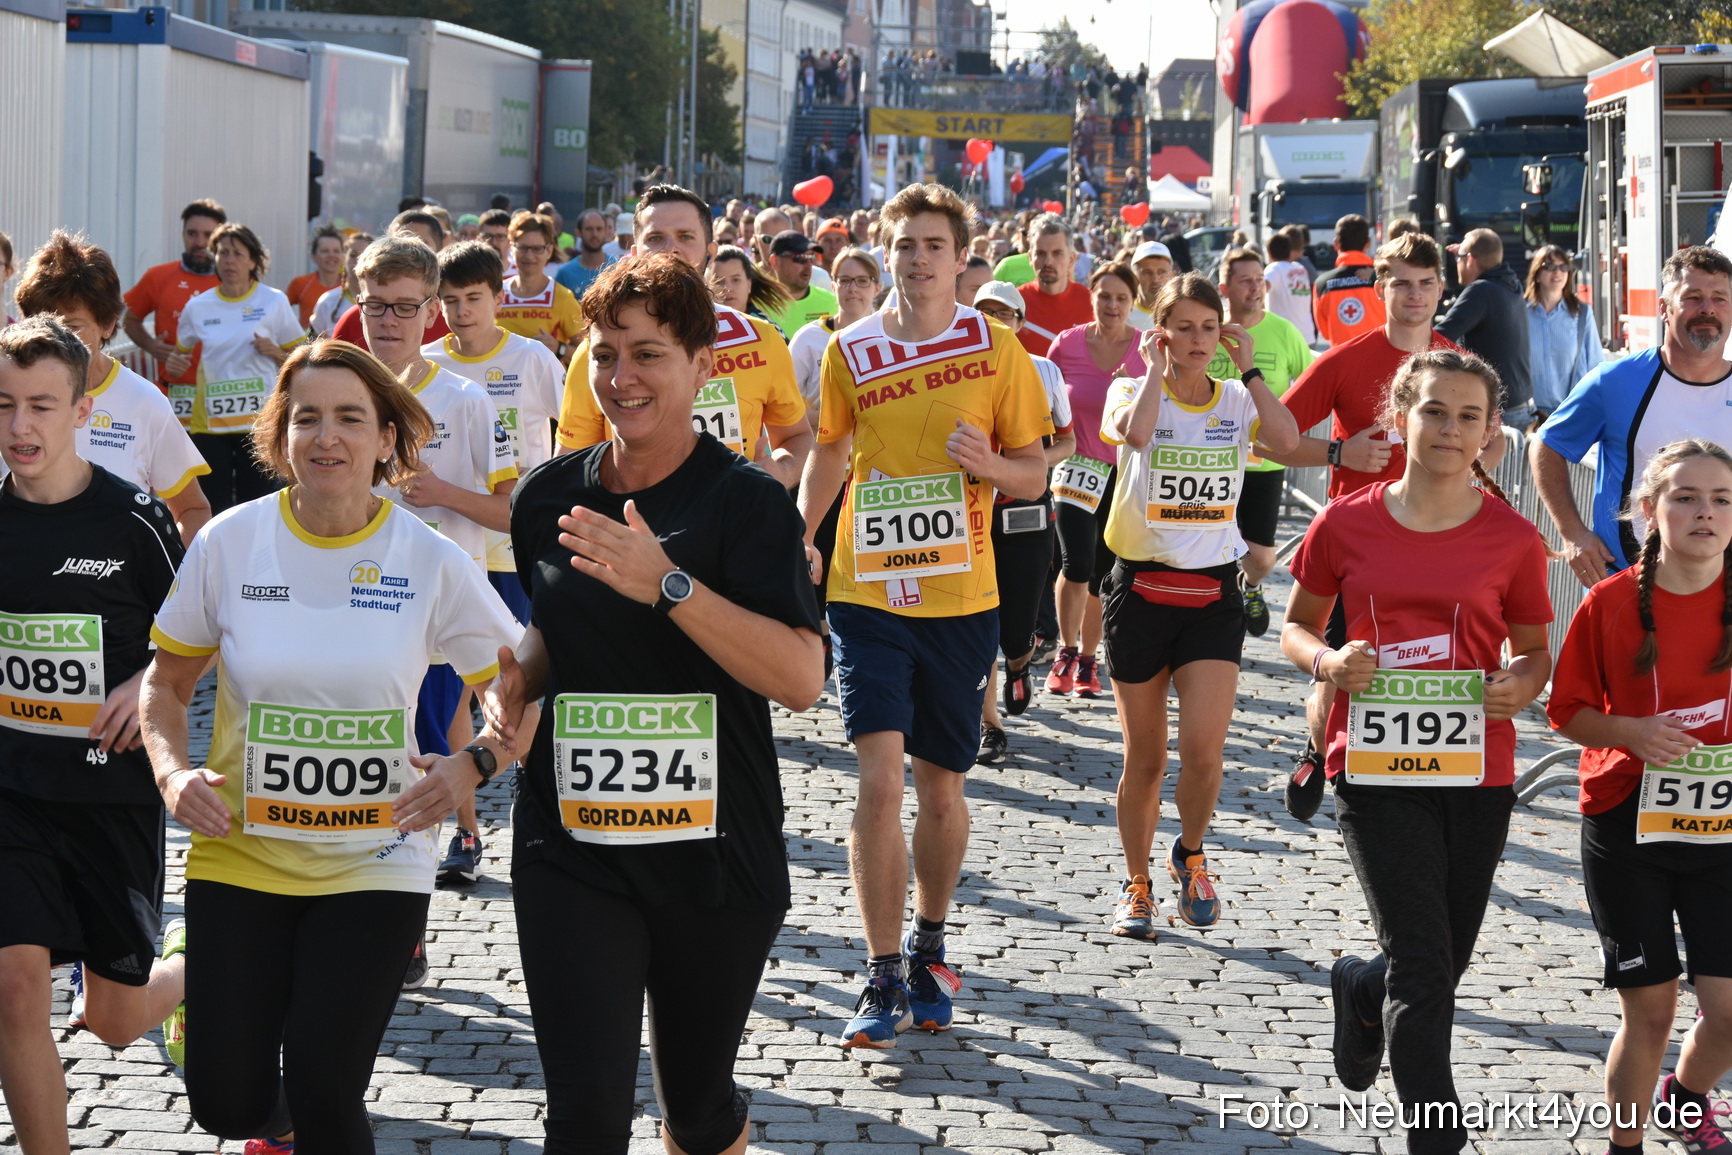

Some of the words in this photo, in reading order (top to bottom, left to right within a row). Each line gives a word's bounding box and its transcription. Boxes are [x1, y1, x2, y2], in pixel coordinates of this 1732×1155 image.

[935, 115, 1006, 134] START
[522, 309, 552, 319] BÖGL
[487, 371, 503, 382] 20
[857, 378, 918, 412] MAX
[925, 360, 996, 390] BÖGL
[210, 379, 261, 394] BOCK
[213, 396, 260, 415] 5273
[91, 414, 111, 428] 20
[1205, 426, 1240, 434] Neumarkter
[1207, 417, 1220, 427] 20
[90, 429, 136, 441] Neumarkter
[90, 439, 126, 450] Stadtlauf
[1157, 448, 1234, 469] BOCK
[1055, 467, 1099, 491] 5119
[1159, 475, 1230, 501] 5043
[861, 478, 954, 508] BOCK
[866, 510, 954, 546] 5100
[52, 558, 106, 576] JURA
[883, 551, 940, 568] JONAS
[352, 567, 379, 584] 20
[383, 577, 406, 586] JAHRE
[241, 584, 290, 598] BOCK
[351, 587, 416, 600] Neumarkter
[350, 599, 402, 613] Stadtlauf
[1397, 645, 1430, 660] DEHN
[1361, 675, 1474, 701] BOCK
[11, 702, 63, 721] LUCA
[566, 701, 702, 734] BOCK
[259, 709, 394, 744] BOCK
[1362, 710, 1467, 745] 5192
[86, 748, 108, 765] 49
[1388, 758, 1441, 772] JOLA
[263, 753, 388, 797] 5009
[570, 748, 697, 792] 5234
[1655, 778, 1732, 810] 519
[267, 806, 380, 826] SUSANNE
[578, 807, 692, 826] GORDANA
[1672, 818, 1732, 832] KATJA
[111, 961, 143, 975] adidas
